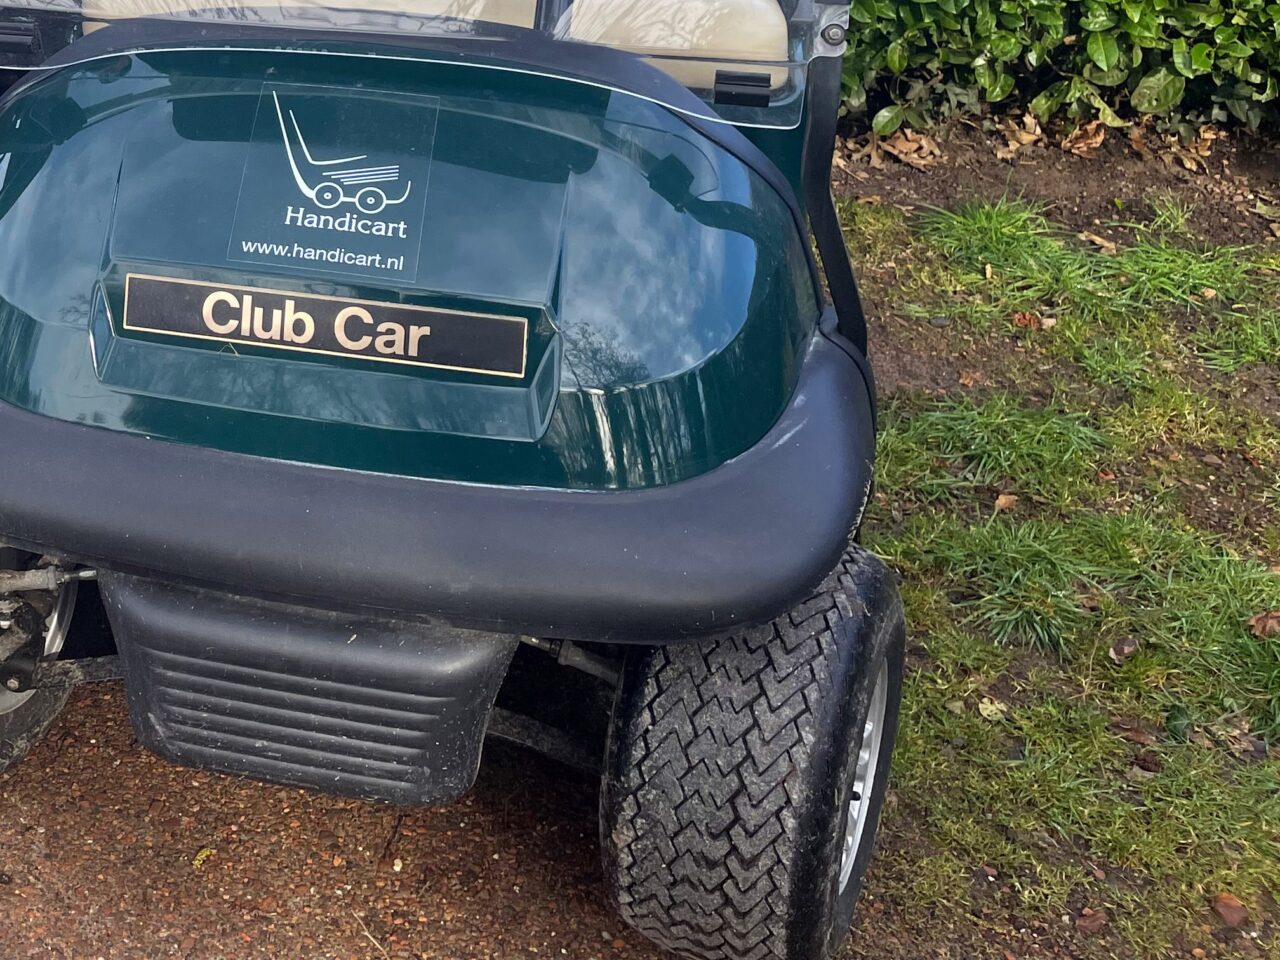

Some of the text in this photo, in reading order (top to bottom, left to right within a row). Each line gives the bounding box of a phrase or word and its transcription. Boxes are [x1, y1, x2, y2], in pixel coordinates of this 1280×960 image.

[284, 206, 408, 239] Handicart
[241, 240, 405, 271] www.handicart.nl
[202, 290, 431, 358] Club Car
